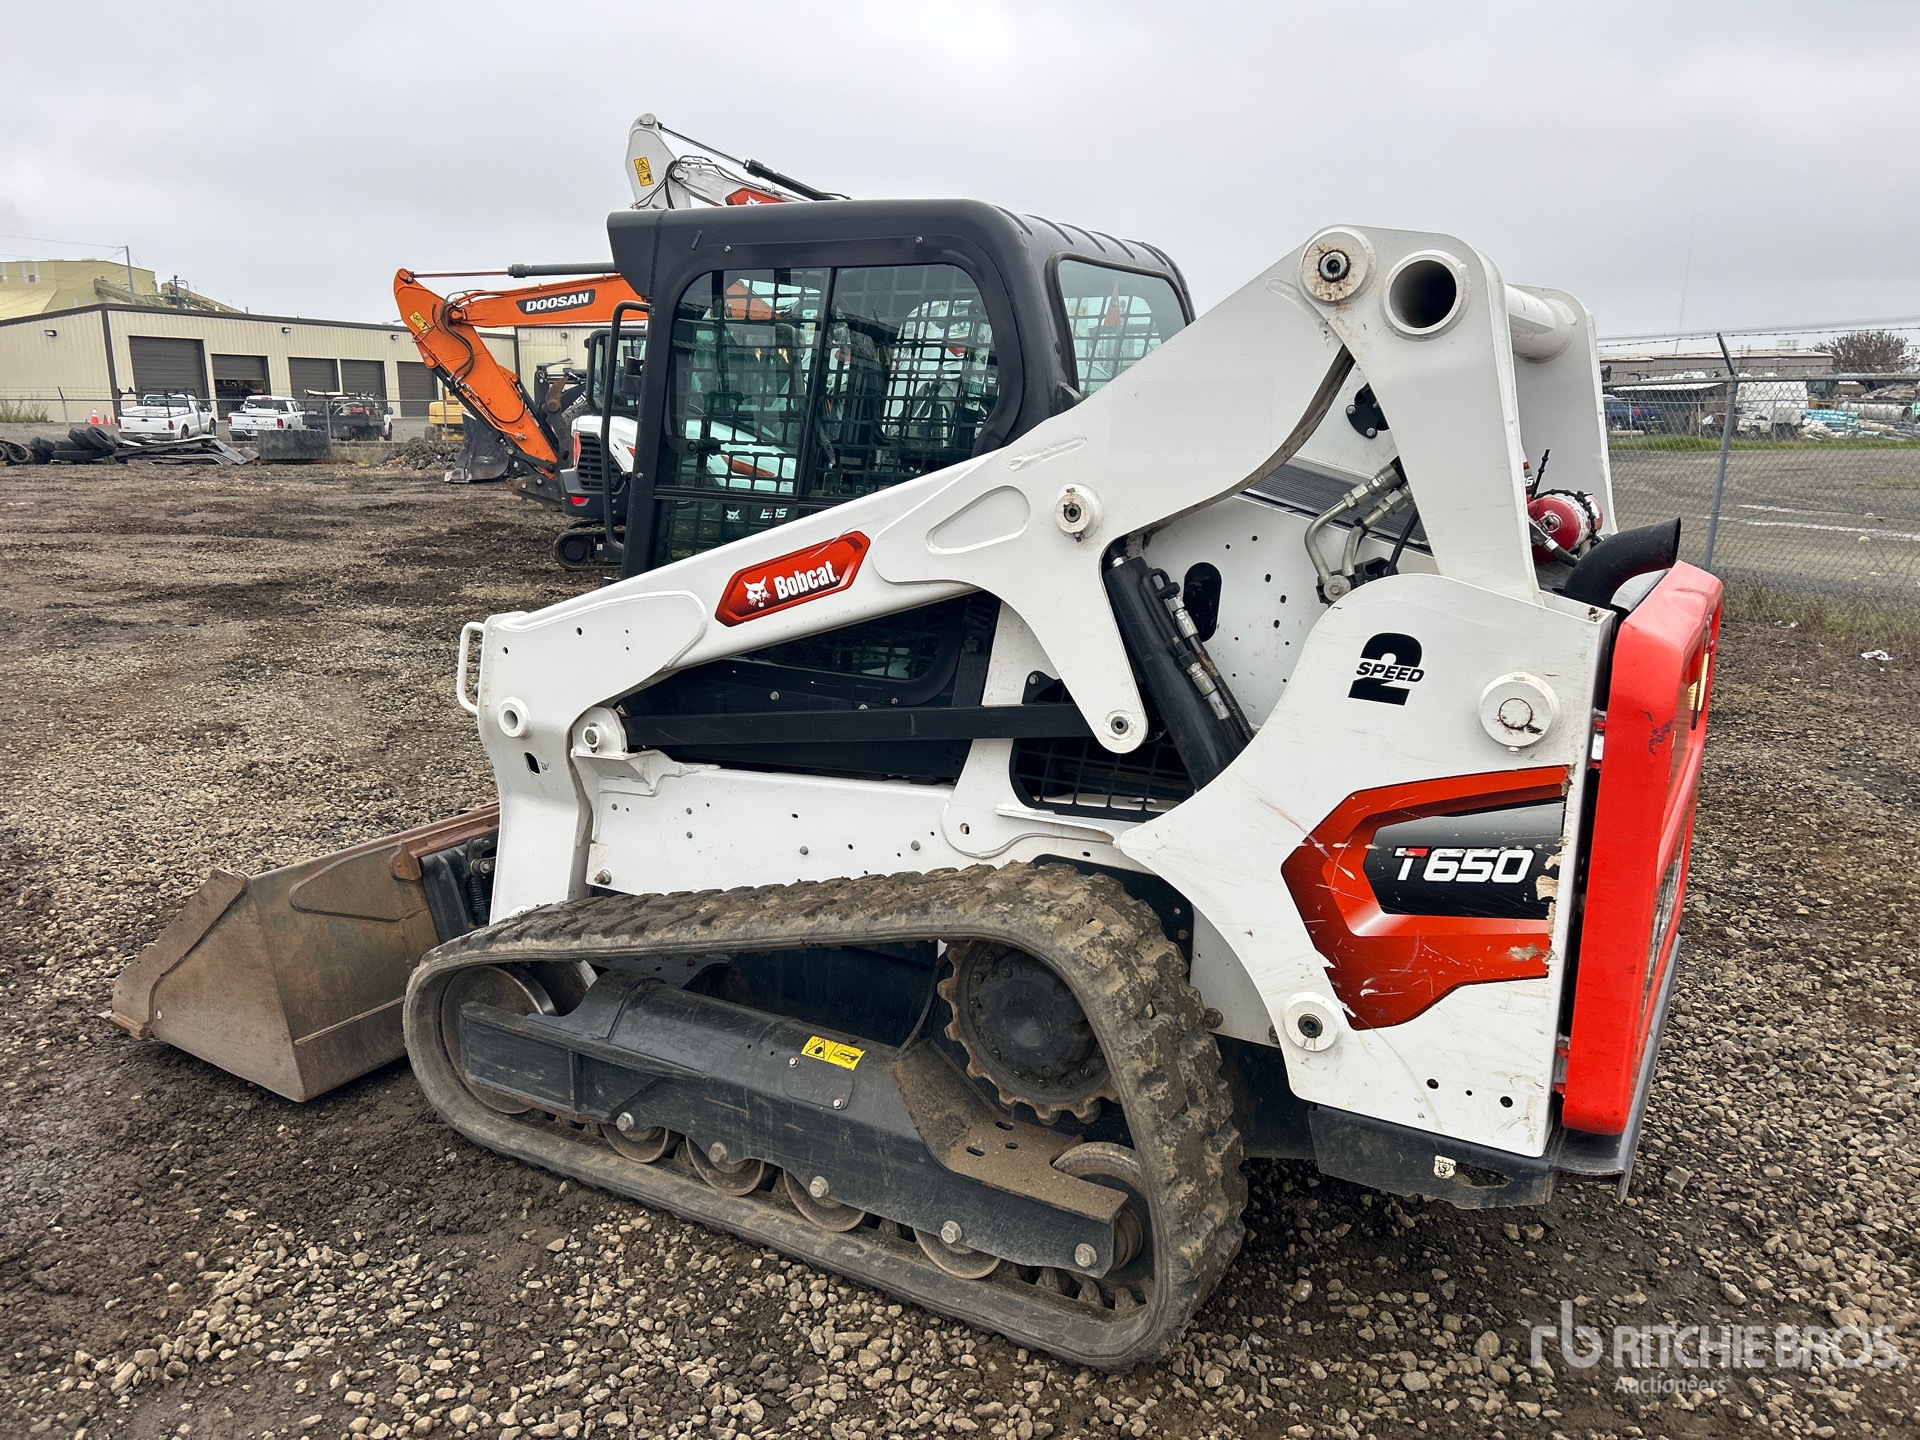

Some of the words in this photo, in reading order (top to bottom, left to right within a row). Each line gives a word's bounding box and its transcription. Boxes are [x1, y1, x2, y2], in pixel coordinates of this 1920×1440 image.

[526, 292, 589, 312] DOOSAN
[773, 560, 837, 600] Bobcat
[1347, 632, 1422, 706] 2
[1355, 661, 1424, 682] SPEED
[1394, 847, 1535, 883] T650
